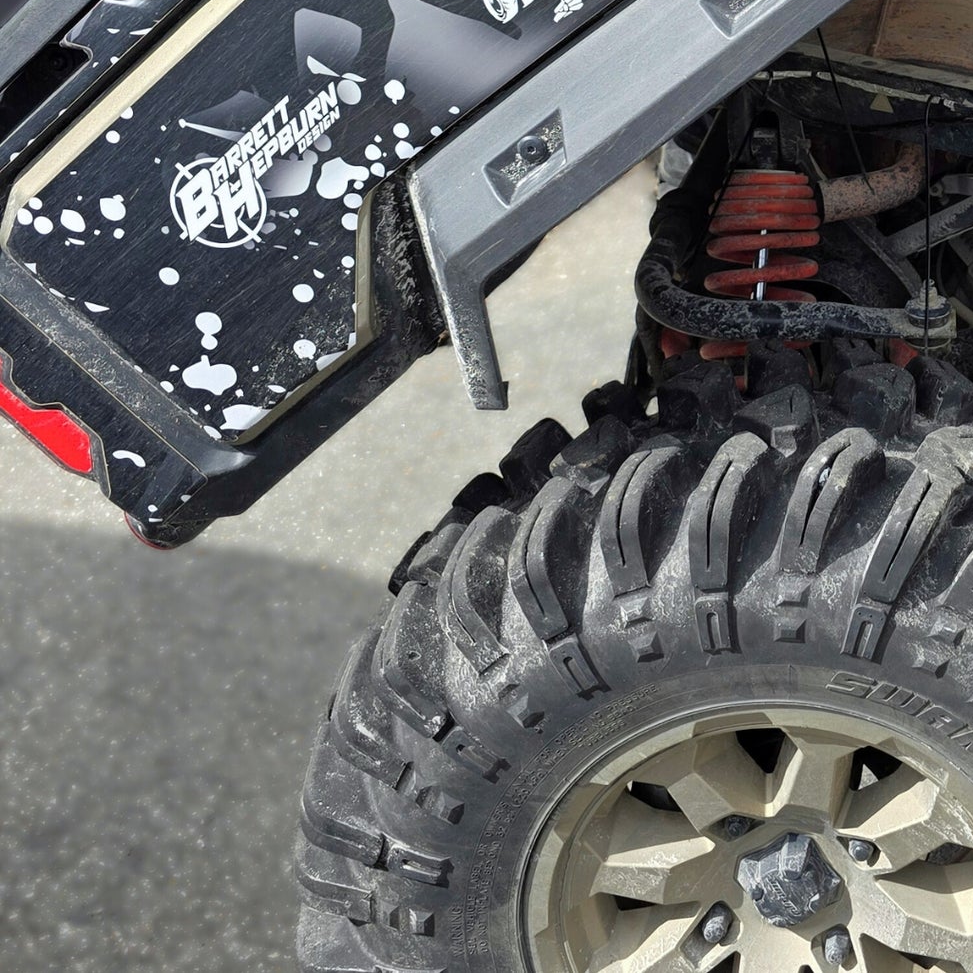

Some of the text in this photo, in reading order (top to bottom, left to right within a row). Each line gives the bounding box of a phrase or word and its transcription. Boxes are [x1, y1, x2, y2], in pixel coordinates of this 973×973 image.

[297, 105, 341, 155] DESIGN
[466, 894, 476, 932] VEHICLE
[477, 843, 488, 856] OR
